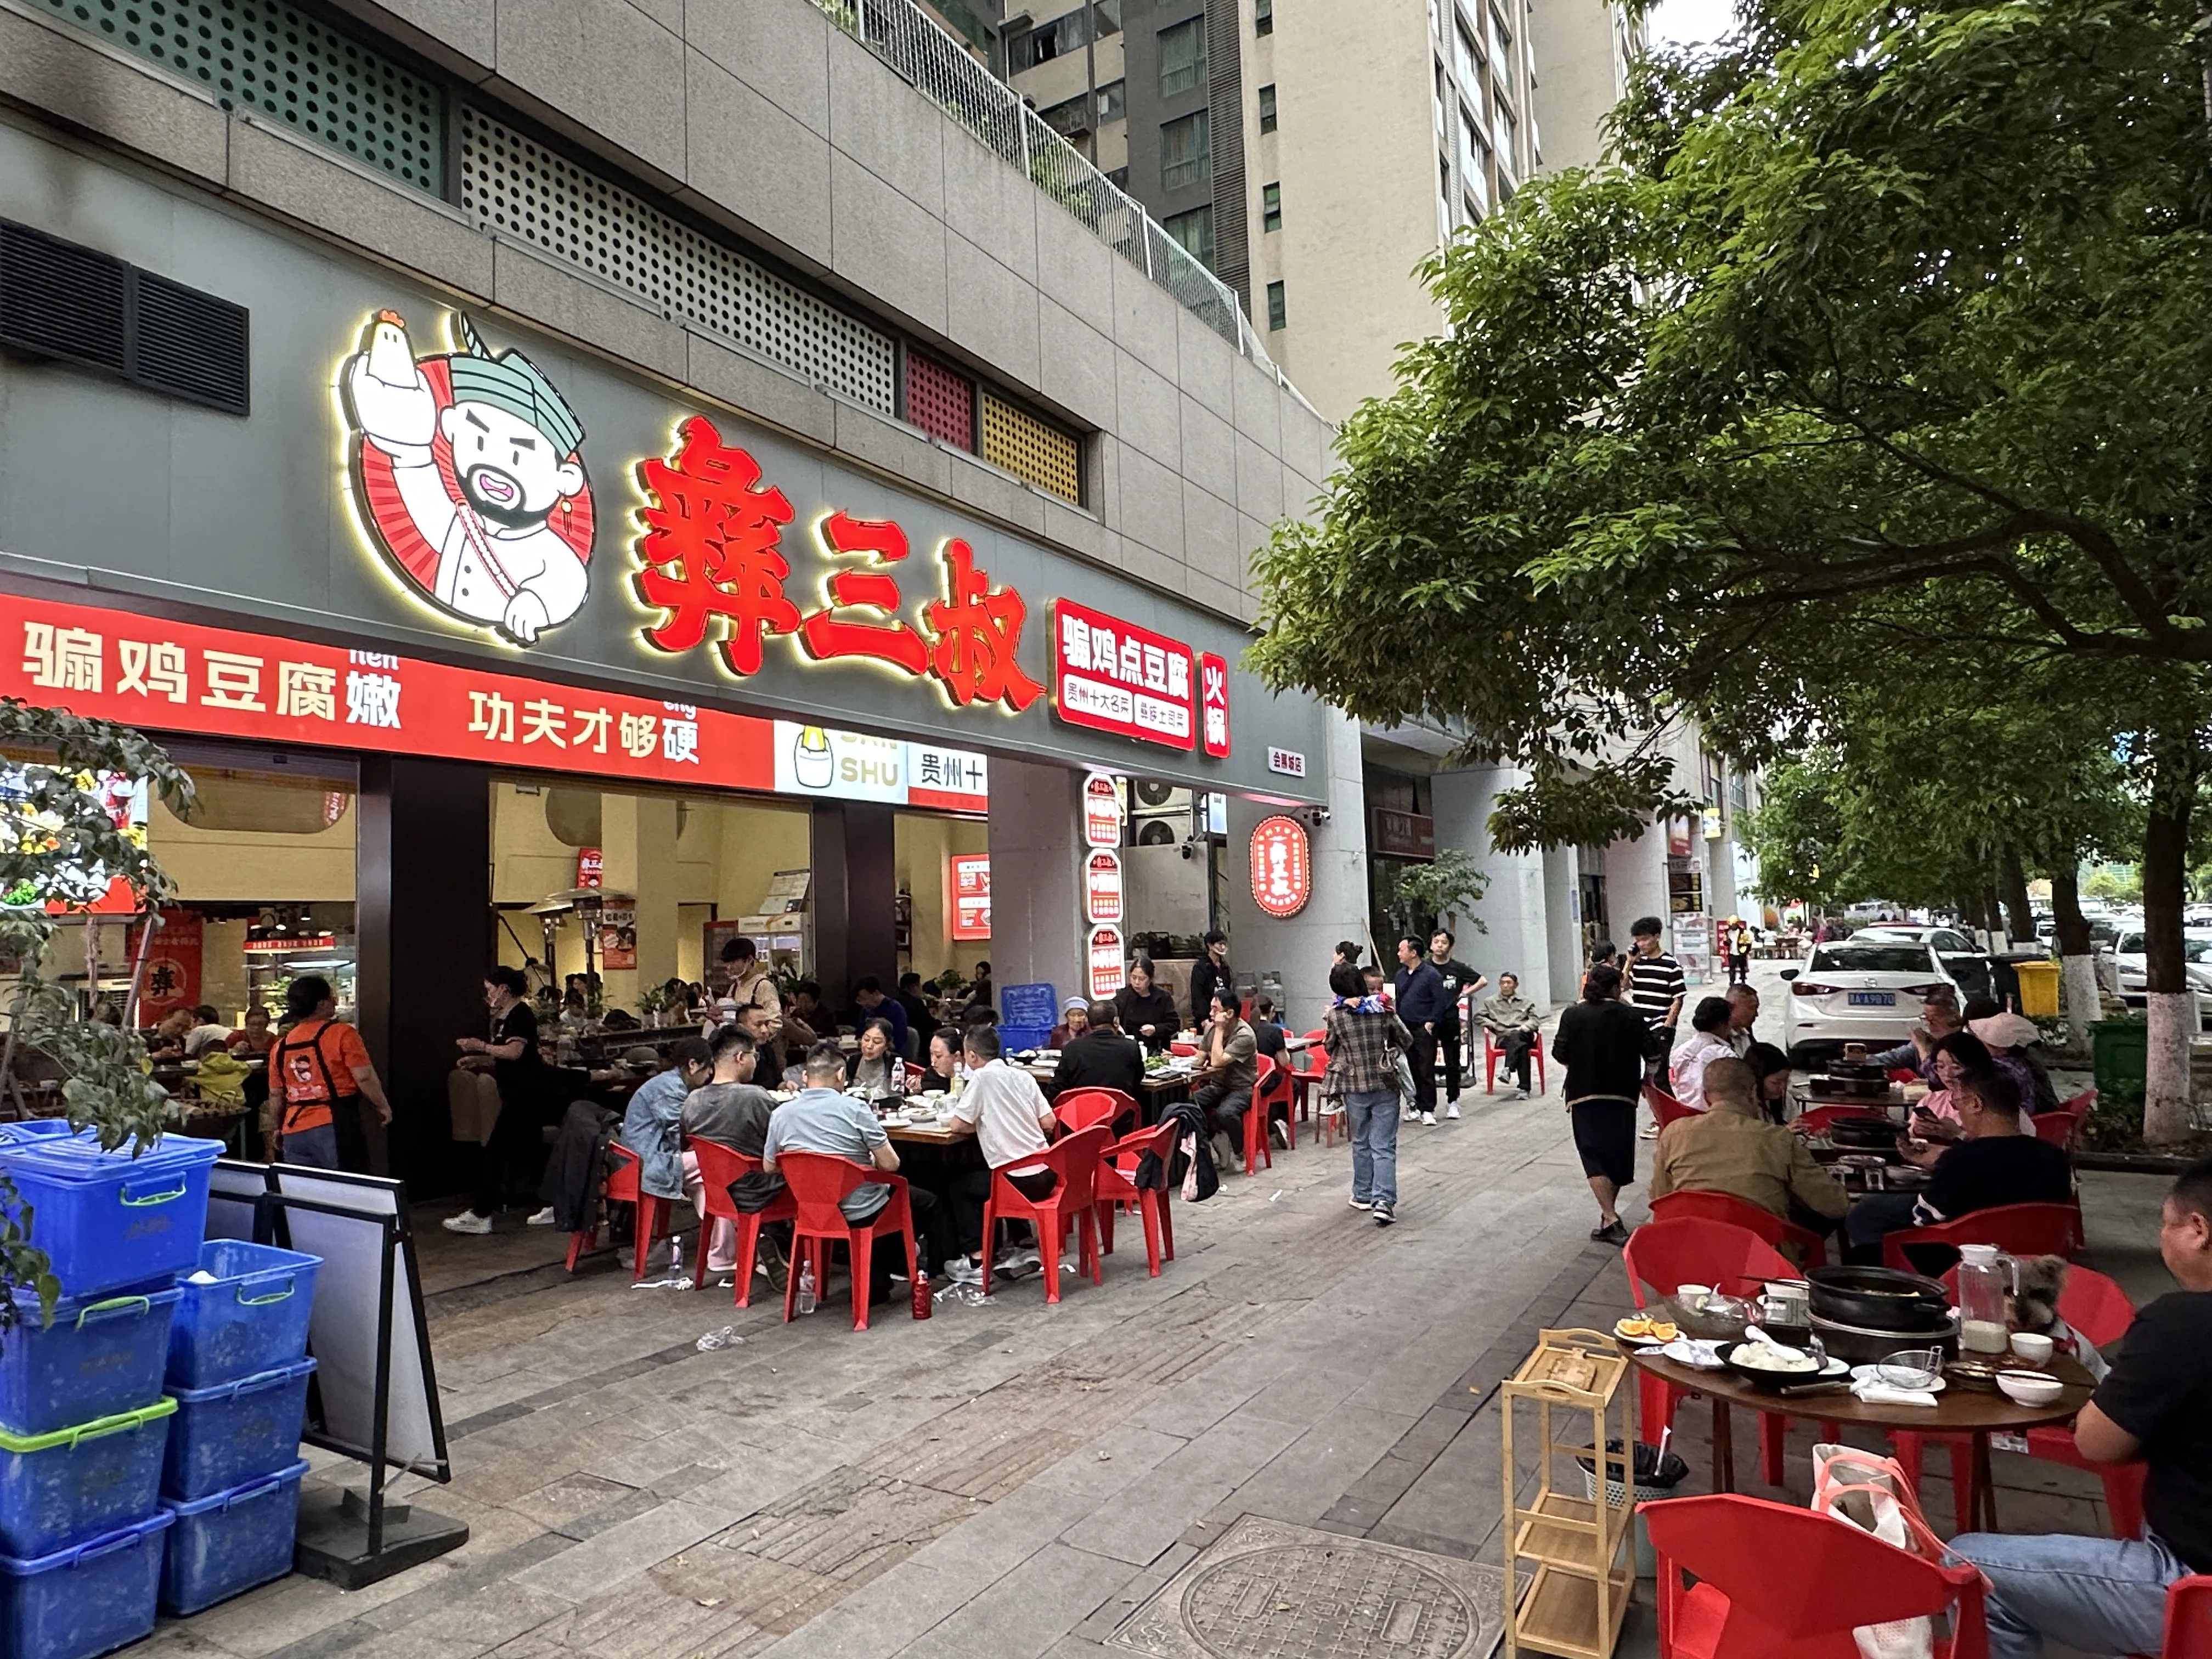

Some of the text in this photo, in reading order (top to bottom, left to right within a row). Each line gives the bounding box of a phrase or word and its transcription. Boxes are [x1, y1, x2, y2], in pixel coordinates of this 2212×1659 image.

[639, 415, 1047, 712] 彝三叔
[468, 691, 700, 764] 功夫才够硬
[840, 758, 898, 787] SHU
[921, 754, 983, 790] 贵州十
